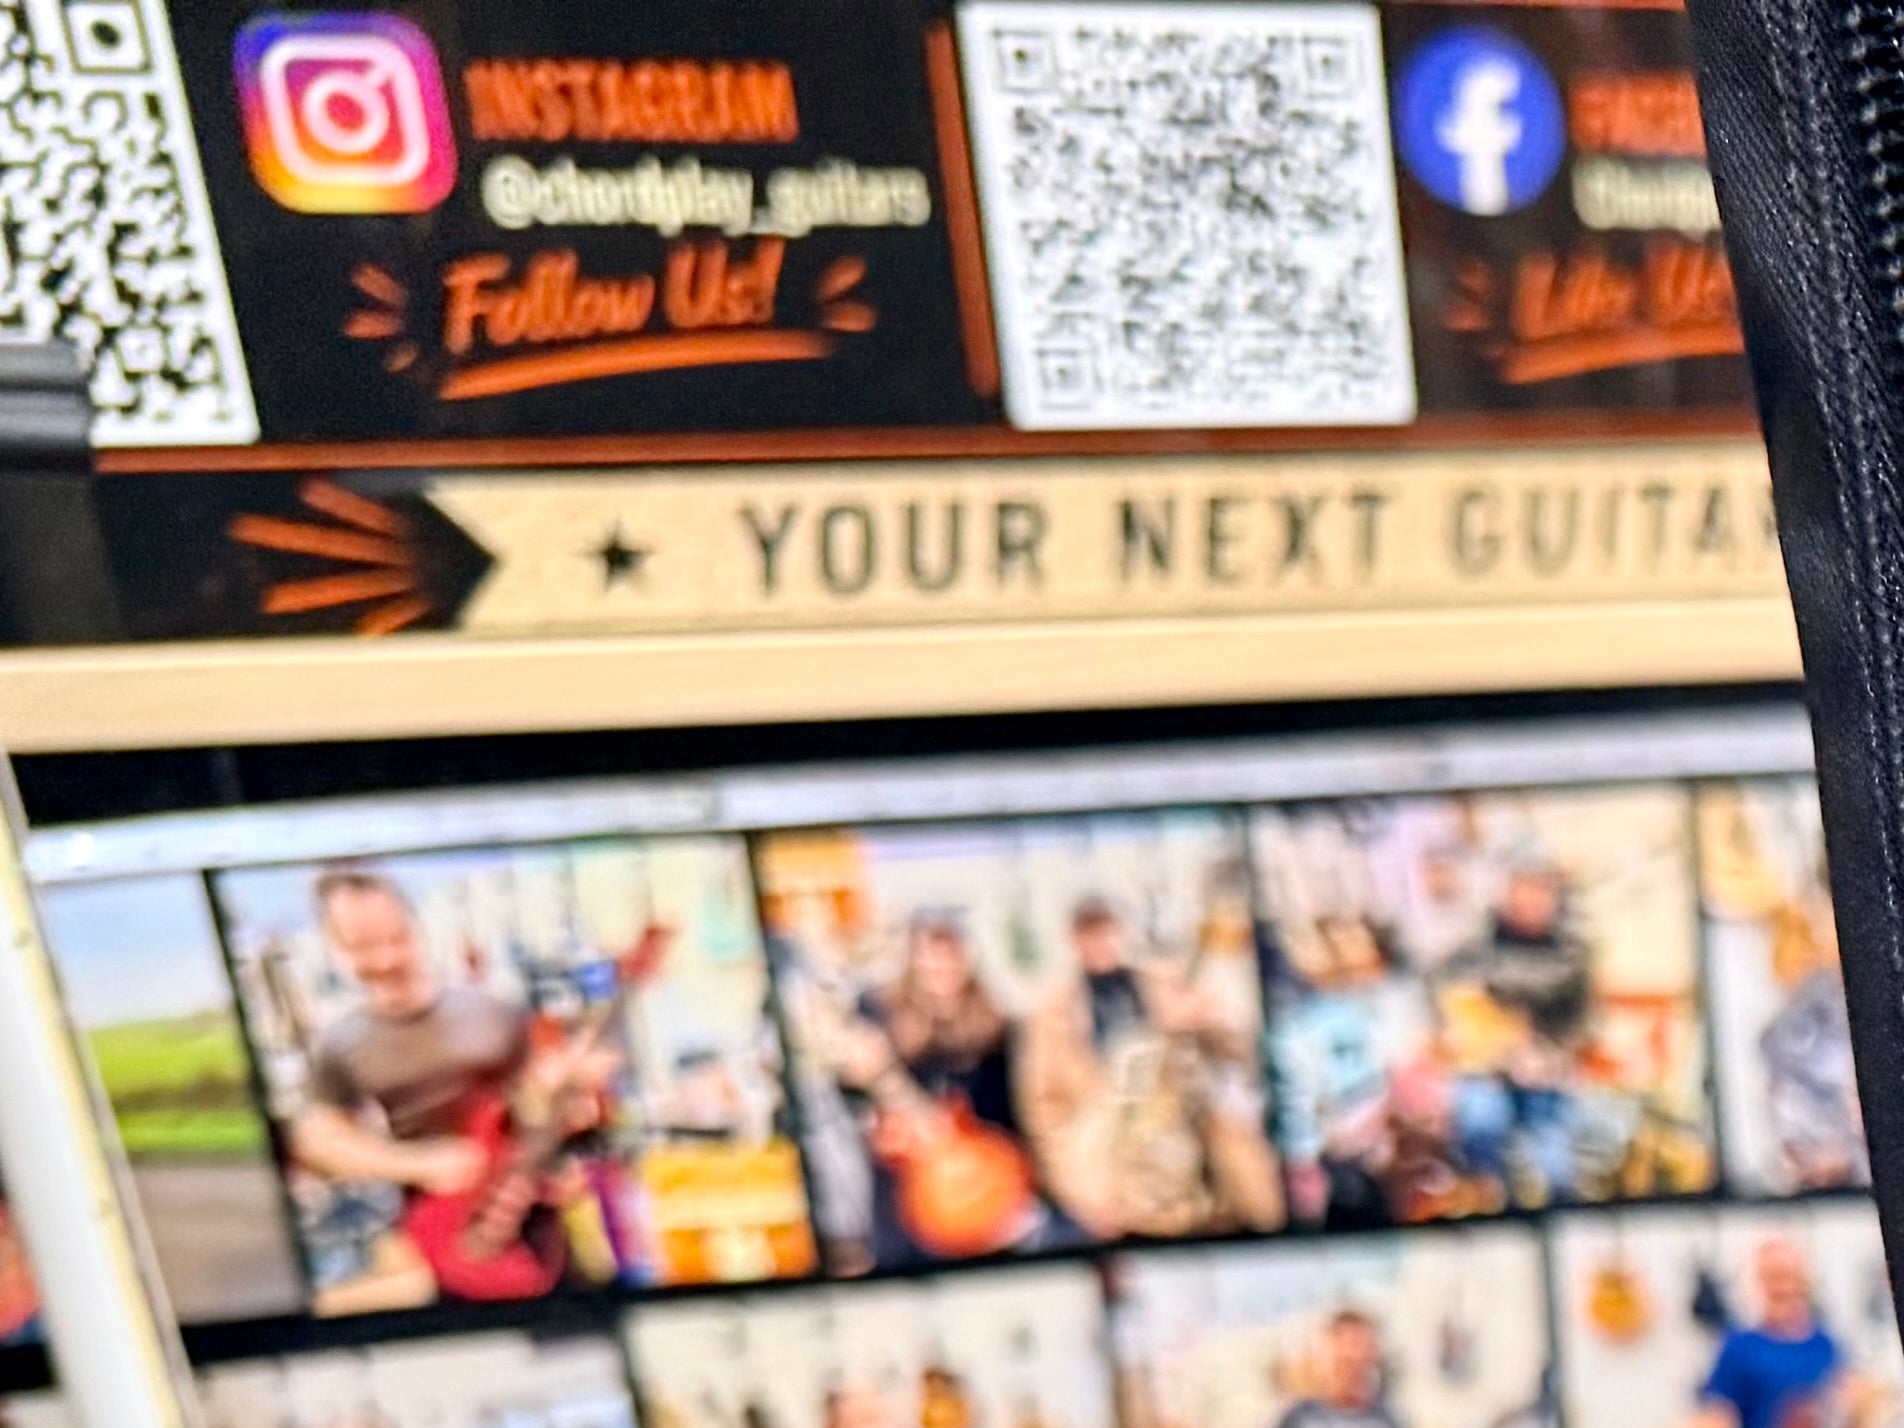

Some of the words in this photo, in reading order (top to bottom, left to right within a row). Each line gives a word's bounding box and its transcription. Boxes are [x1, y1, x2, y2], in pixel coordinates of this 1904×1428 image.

[464, 58, 799, 142] INSTAGRAM
[442, 249, 656, 355] Follow
[737, 496, 1050, 598] YOUR
[1116, 488, 1394, 587] NEXT
